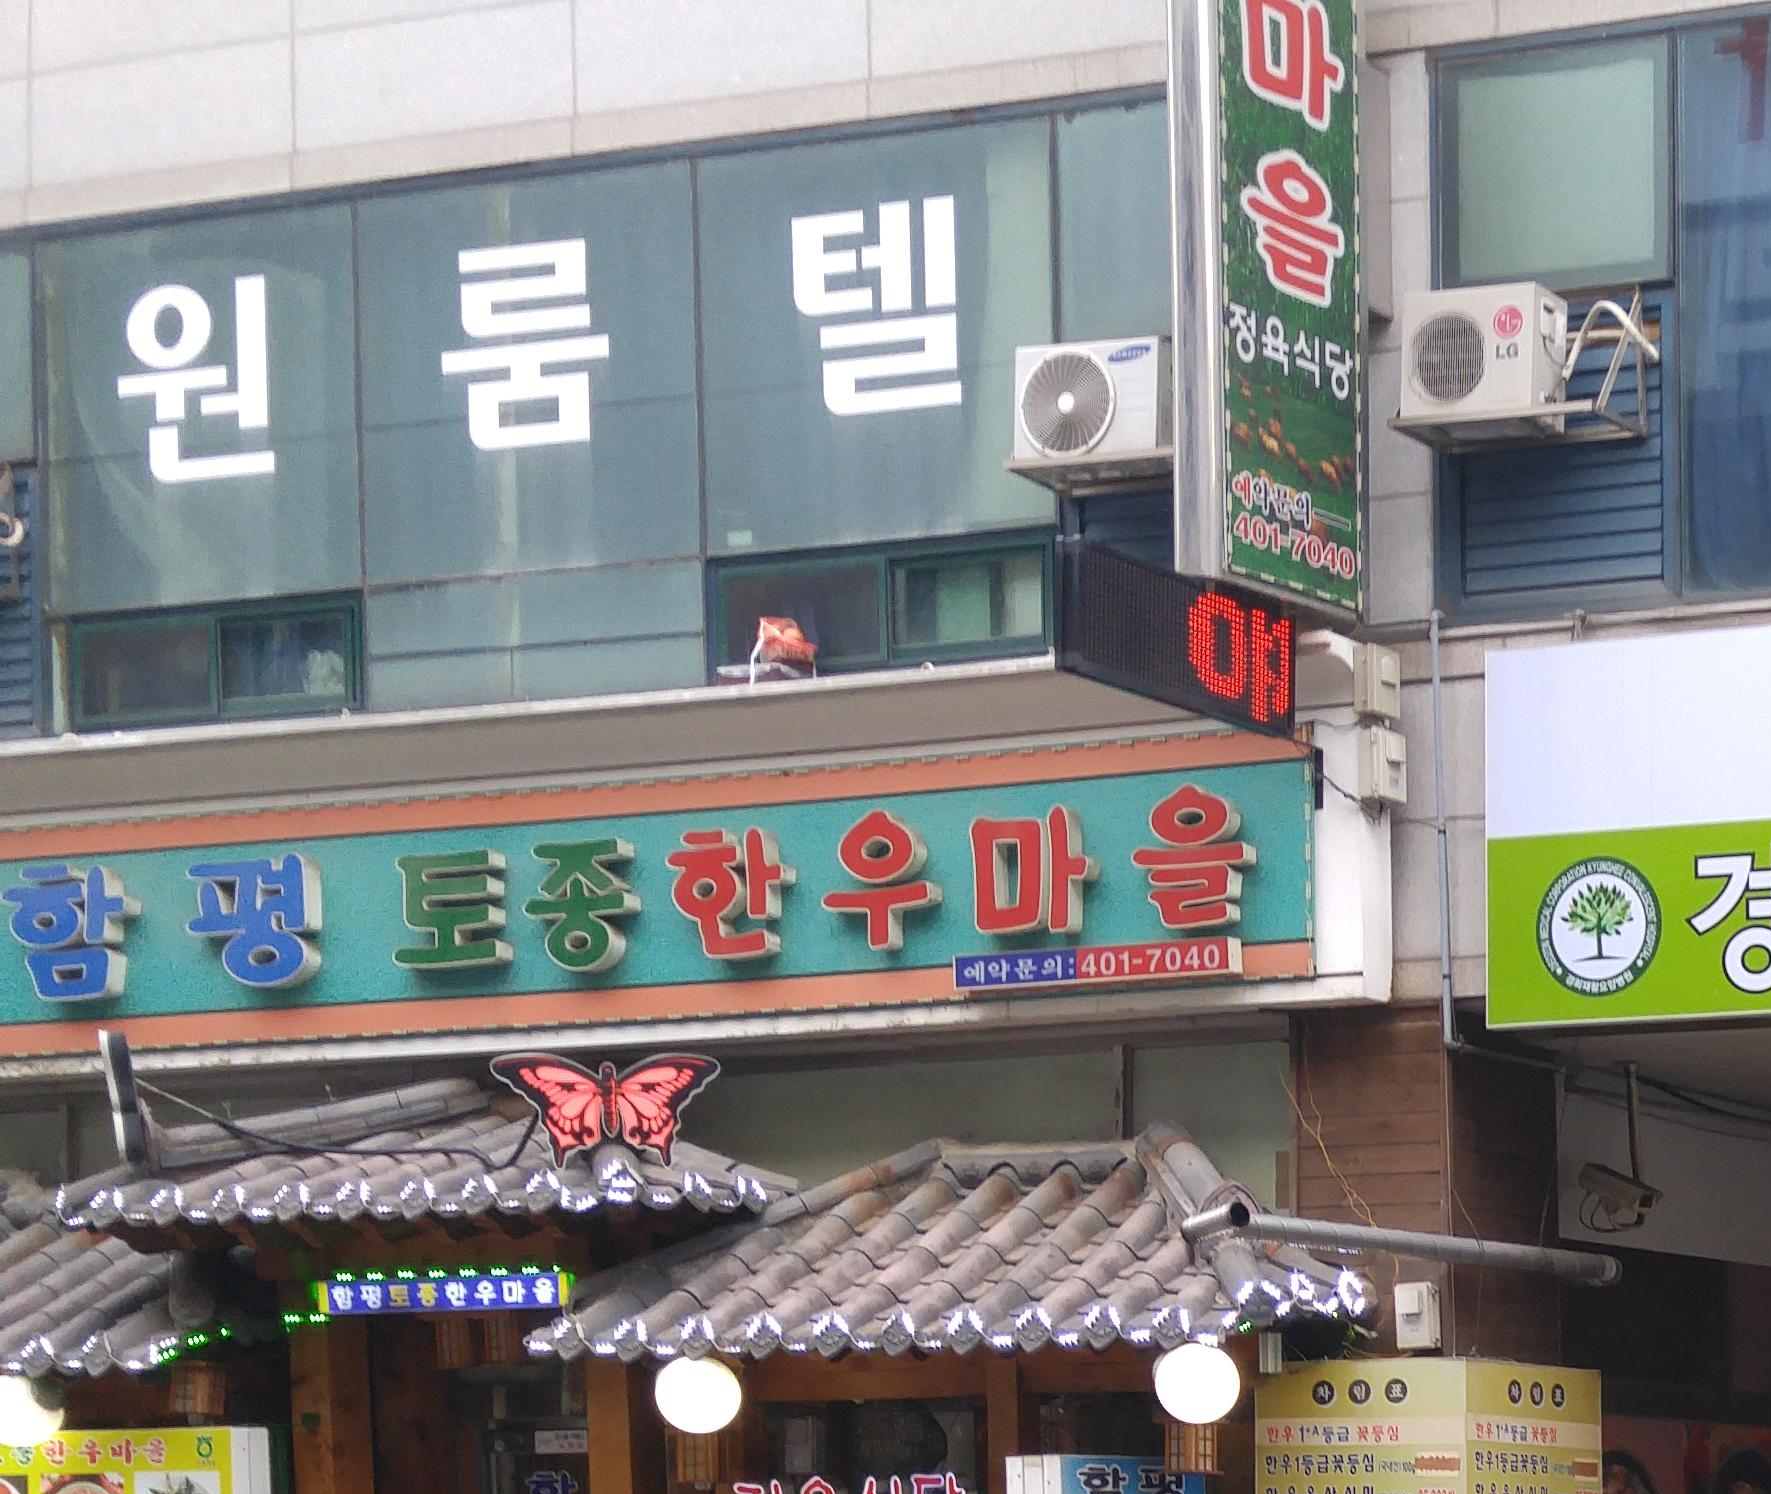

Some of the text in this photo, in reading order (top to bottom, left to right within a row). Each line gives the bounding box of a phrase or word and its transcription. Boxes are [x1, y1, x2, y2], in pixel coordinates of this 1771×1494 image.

[1228, 302, 1352, 399] 정육식당
[1494, 342, 1519, 359] LG
[1234, 511, 1355, 579] 401-7040
[1081, 943, 1222, 978] 401-7040
